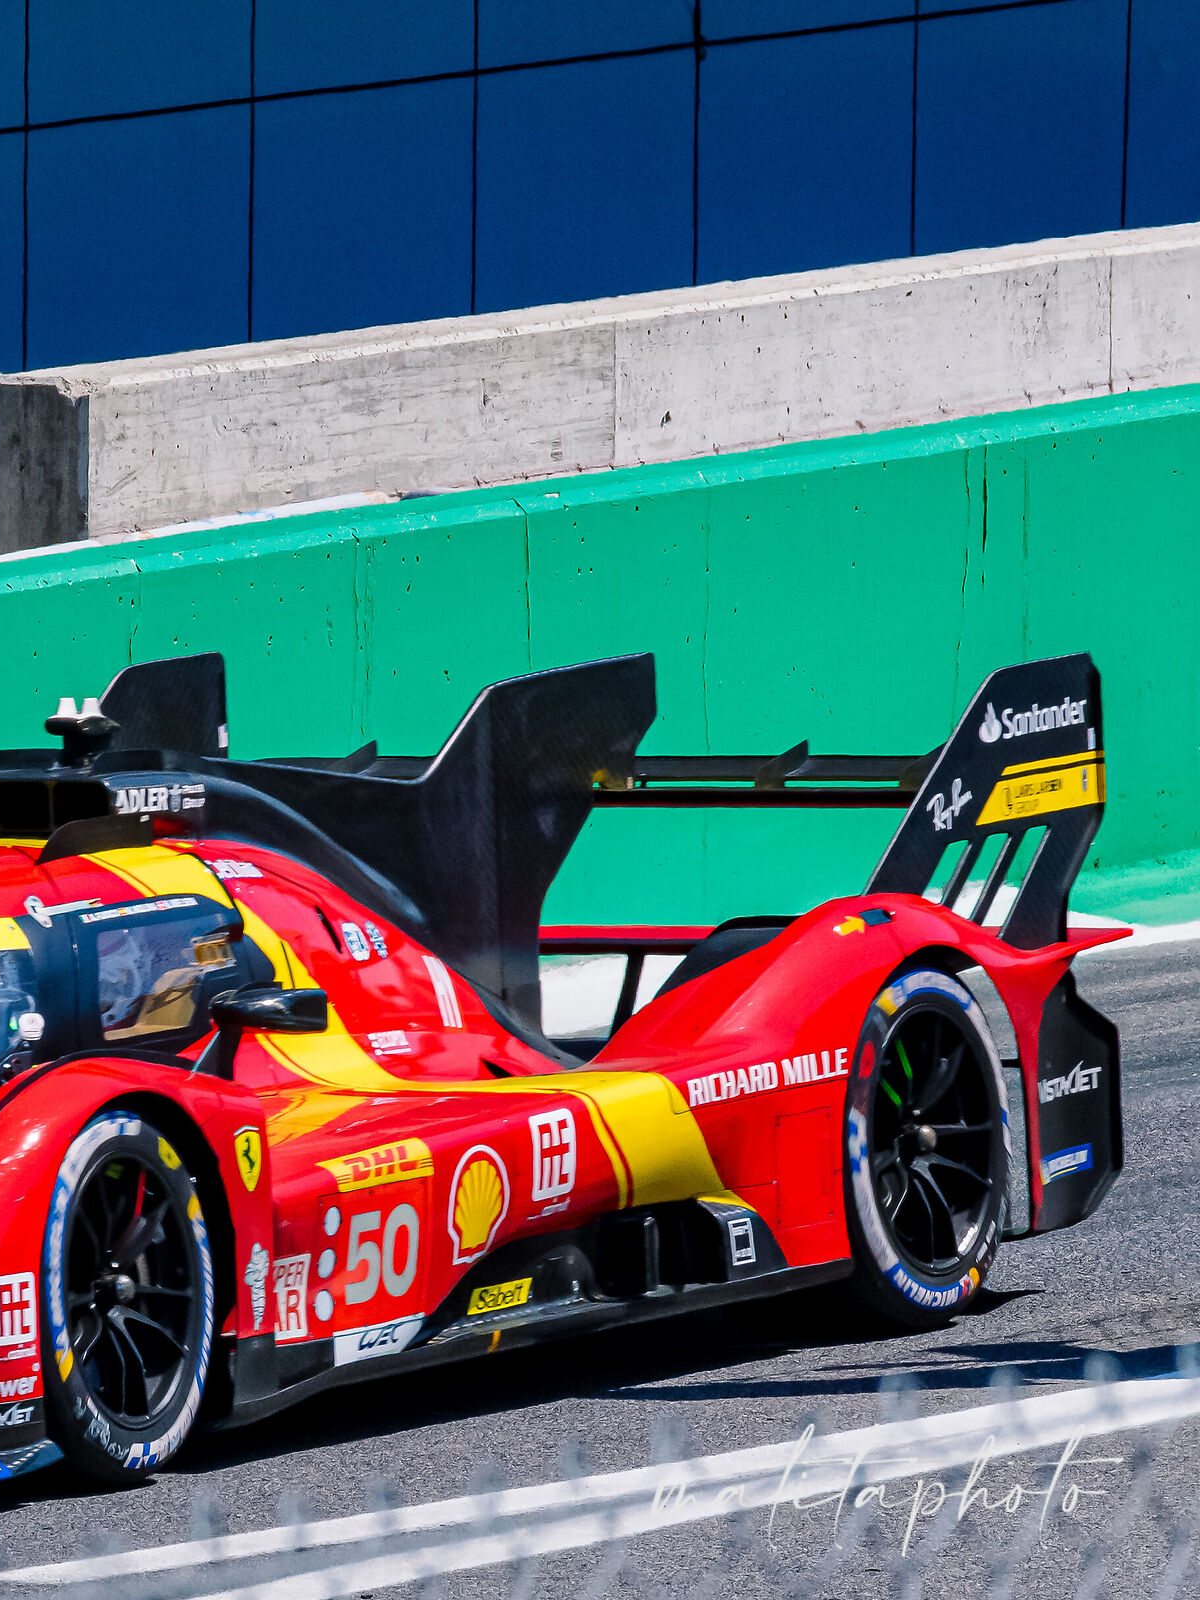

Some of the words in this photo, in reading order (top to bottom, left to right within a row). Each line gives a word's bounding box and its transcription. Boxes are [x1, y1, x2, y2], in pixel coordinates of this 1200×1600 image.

[1001, 696, 1087, 740] Santander
[115, 787, 169, 815] ADLER
[687, 1061, 779, 1107] RICHARD
[780, 1048, 849, 1086] MILLE
[343, 1145, 420, 1182] DHL
[345, 1203, 420, 1306] 50
[273, 1260, 305, 1289] PER
[893, 1268, 960, 1307] MICHELIN
[358, 1322, 404, 1351] WEC
